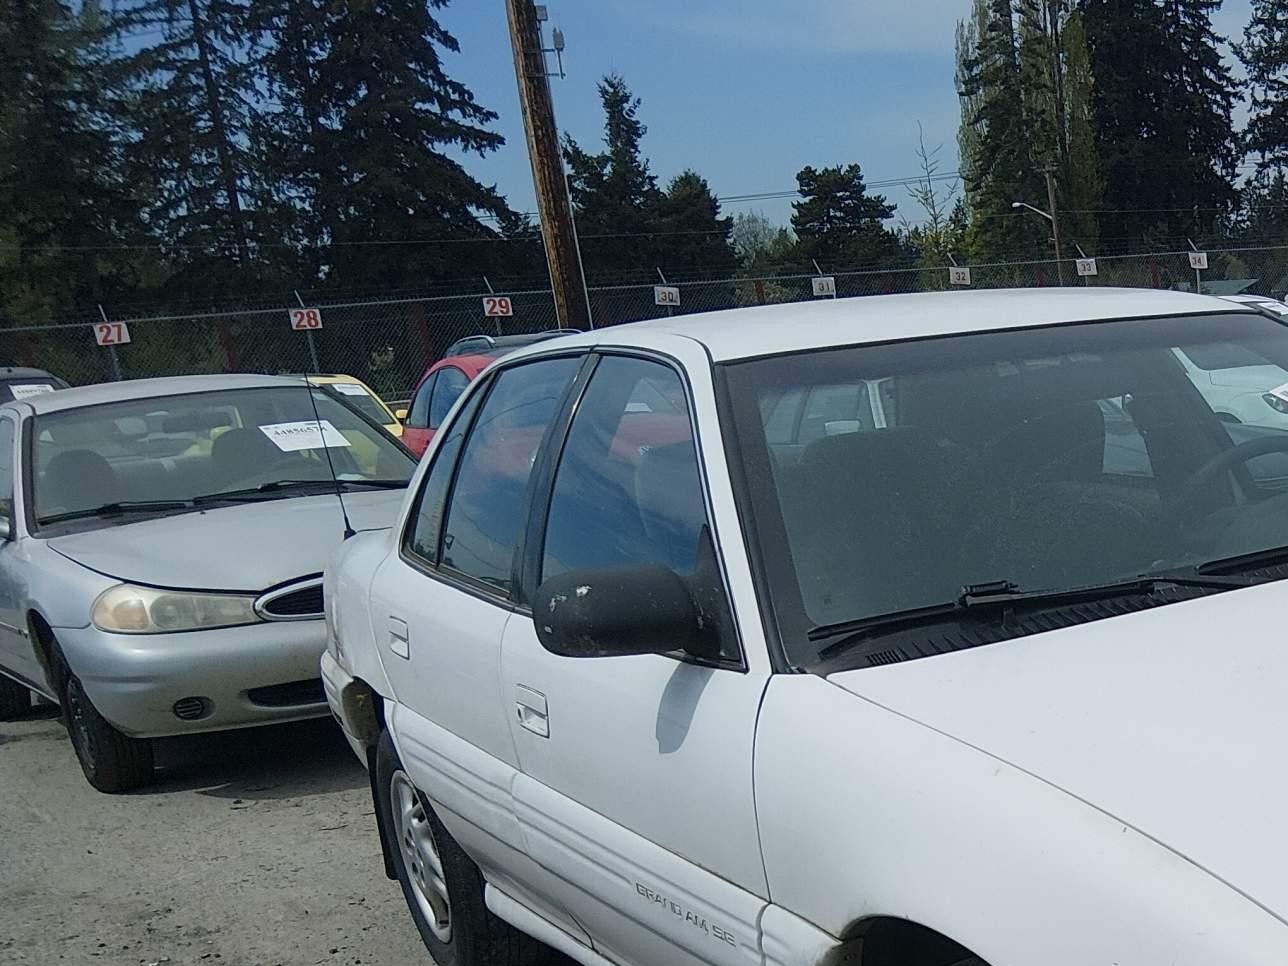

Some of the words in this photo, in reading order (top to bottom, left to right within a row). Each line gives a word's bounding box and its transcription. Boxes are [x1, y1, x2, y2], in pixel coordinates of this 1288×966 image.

[955, 271, 966, 281] 32
[818, 282, 830, 292] 31
[660, 291, 673, 302] 30
[486, 299, 510, 315] 29
[293, 310, 319, 329] 28
[98, 323, 122, 344] 27
[636, 882, 682, 916] GRAND
[685, 911, 709, 934] AM
[712, 925, 737, 948] SE
